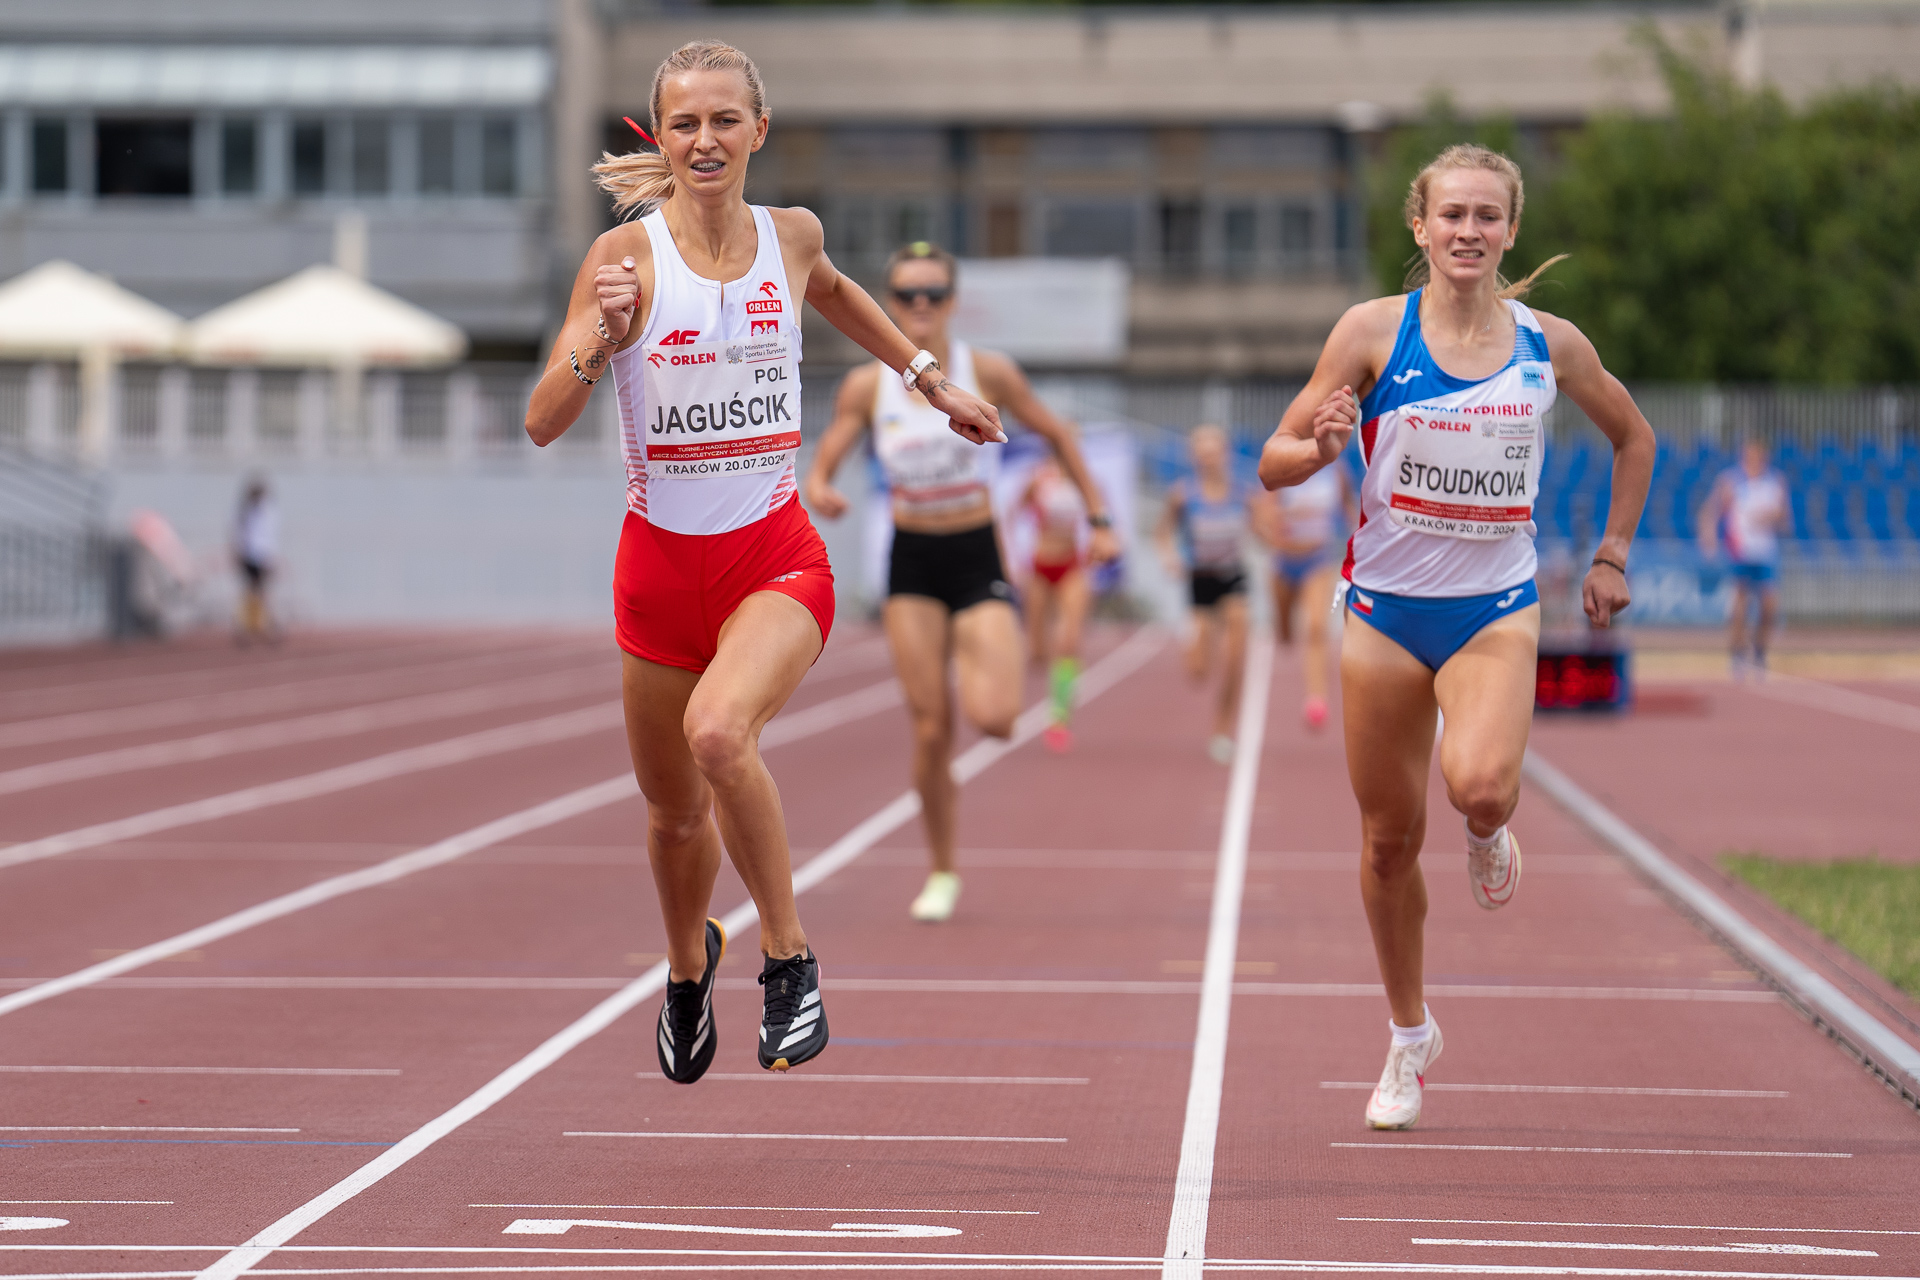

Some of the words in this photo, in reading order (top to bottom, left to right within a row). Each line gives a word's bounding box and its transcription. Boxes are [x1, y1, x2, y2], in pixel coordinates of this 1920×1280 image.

[748, 301, 780, 312] ORLEN
[744, 342, 778, 351] Ministerstwo
[670, 352, 716, 366] ORLEN
[755, 366, 787, 384] POL
[651, 392, 791, 434] JAGUŚCIK
[1429, 420, 1471, 433] ORLEN
[677, 445, 704, 453] TURNIEJ
[1504, 445, 1531, 460] CZE
[665, 461, 721, 474] KRAKÓW
[724, 454, 786, 471] 20.07.2024
[1400, 454, 1526, 496] ŠTOUDKOVÁ
[1404, 514, 1456, 531] KRAKÓW
[1459, 522, 1516, 535] 20.07.2024
